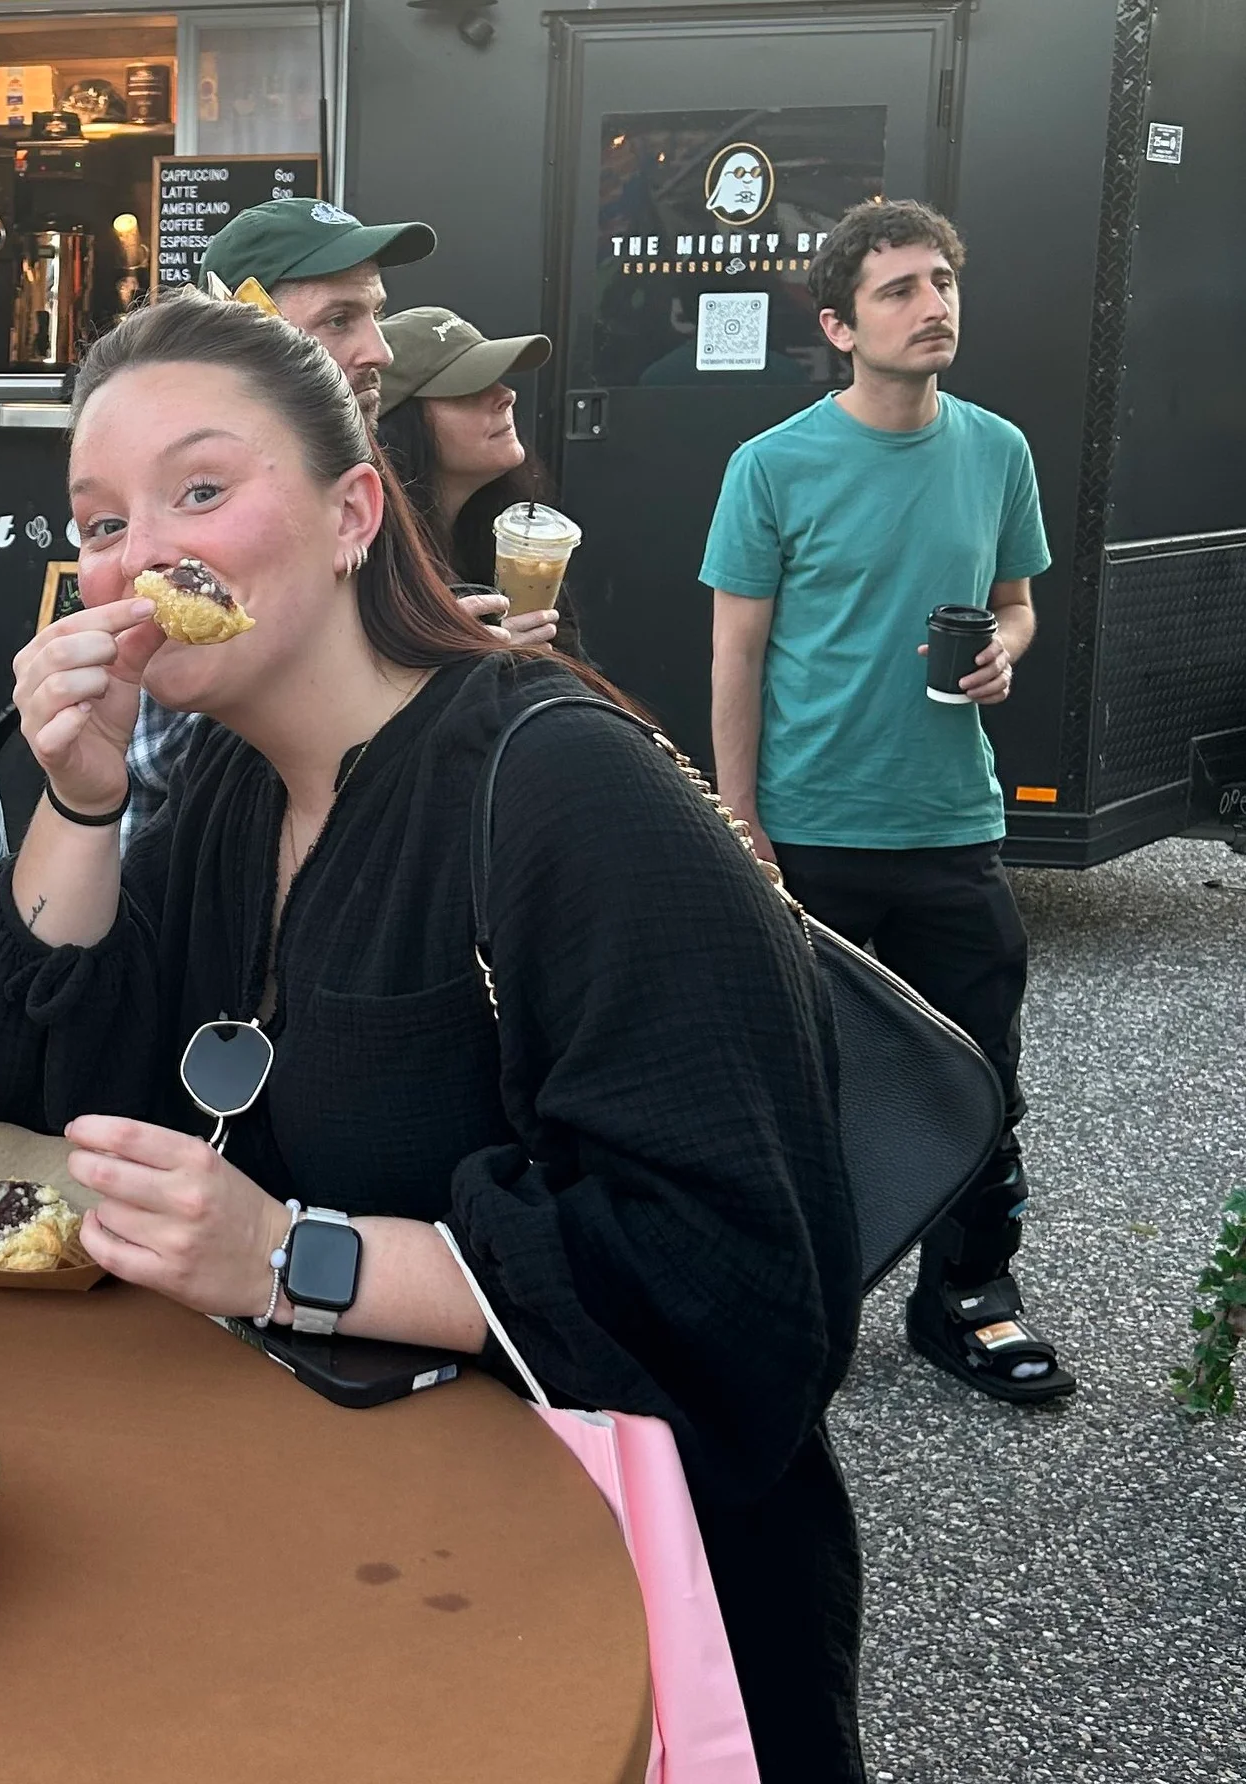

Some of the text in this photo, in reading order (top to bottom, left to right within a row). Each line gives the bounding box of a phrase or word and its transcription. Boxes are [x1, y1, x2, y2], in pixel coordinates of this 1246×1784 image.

[161, 168, 295, 183] CAPPUCCINO 600
[161, 186, 293, 199] LATTE 600
[161, 202, 230, 215] AMERICANO
[160, 219, 204, 231] COFFEE
[611, 236, 659, 256] THE
[676, 234, 779, 255] MIGHTY
[158, 252, 187, 265] CHAI
[623, 258, 811, 274] ESPRESSO YOURS
[159, 268, 191, 282] TEAS
